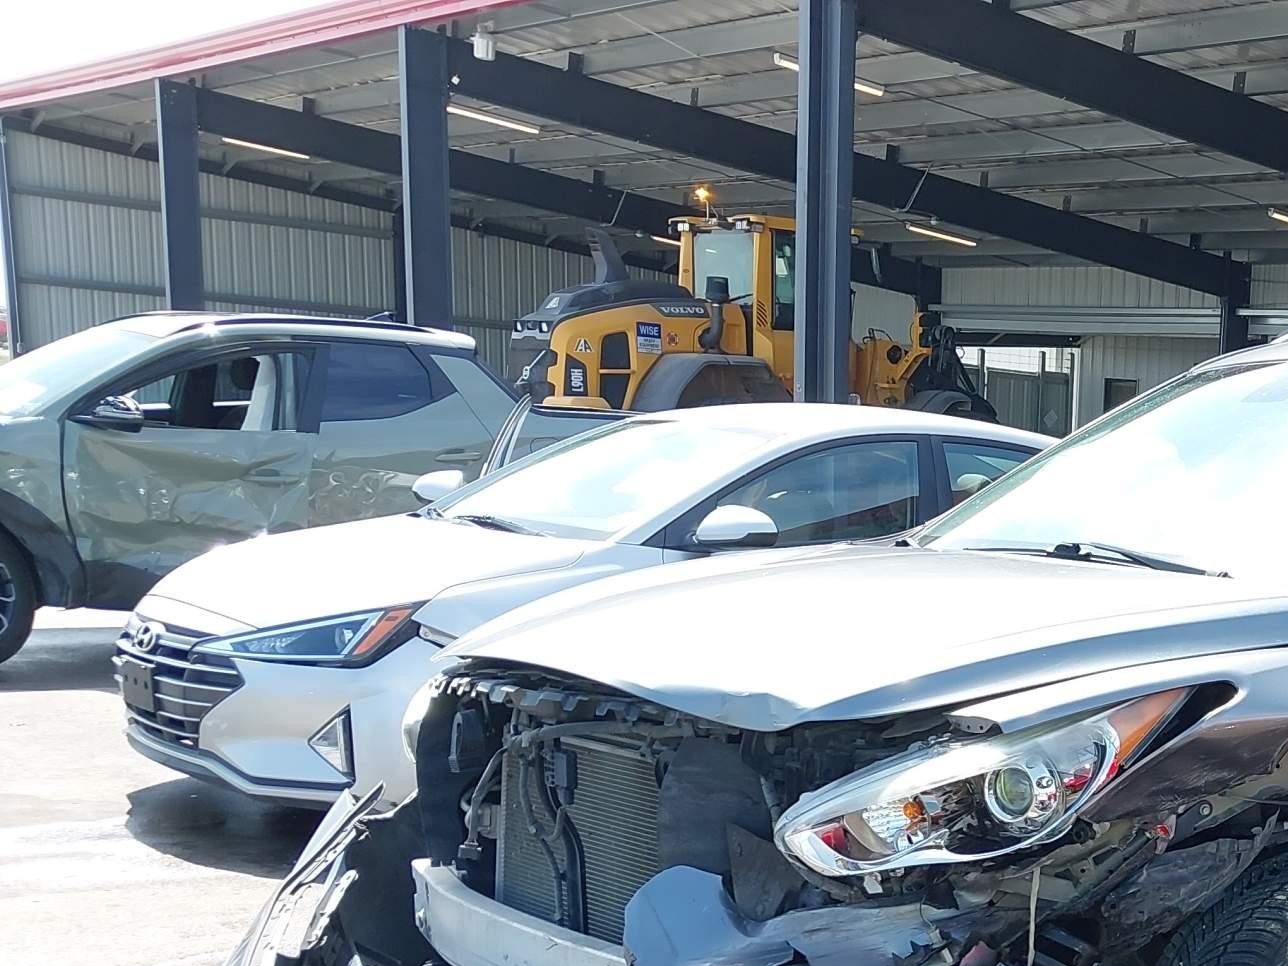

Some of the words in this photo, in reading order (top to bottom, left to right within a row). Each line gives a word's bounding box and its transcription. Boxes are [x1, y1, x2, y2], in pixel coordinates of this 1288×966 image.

[659, 306, 705, 314] VOLVO
[639, 325, 659, 336] WISE
[570, 368, 584, 392] L90H
